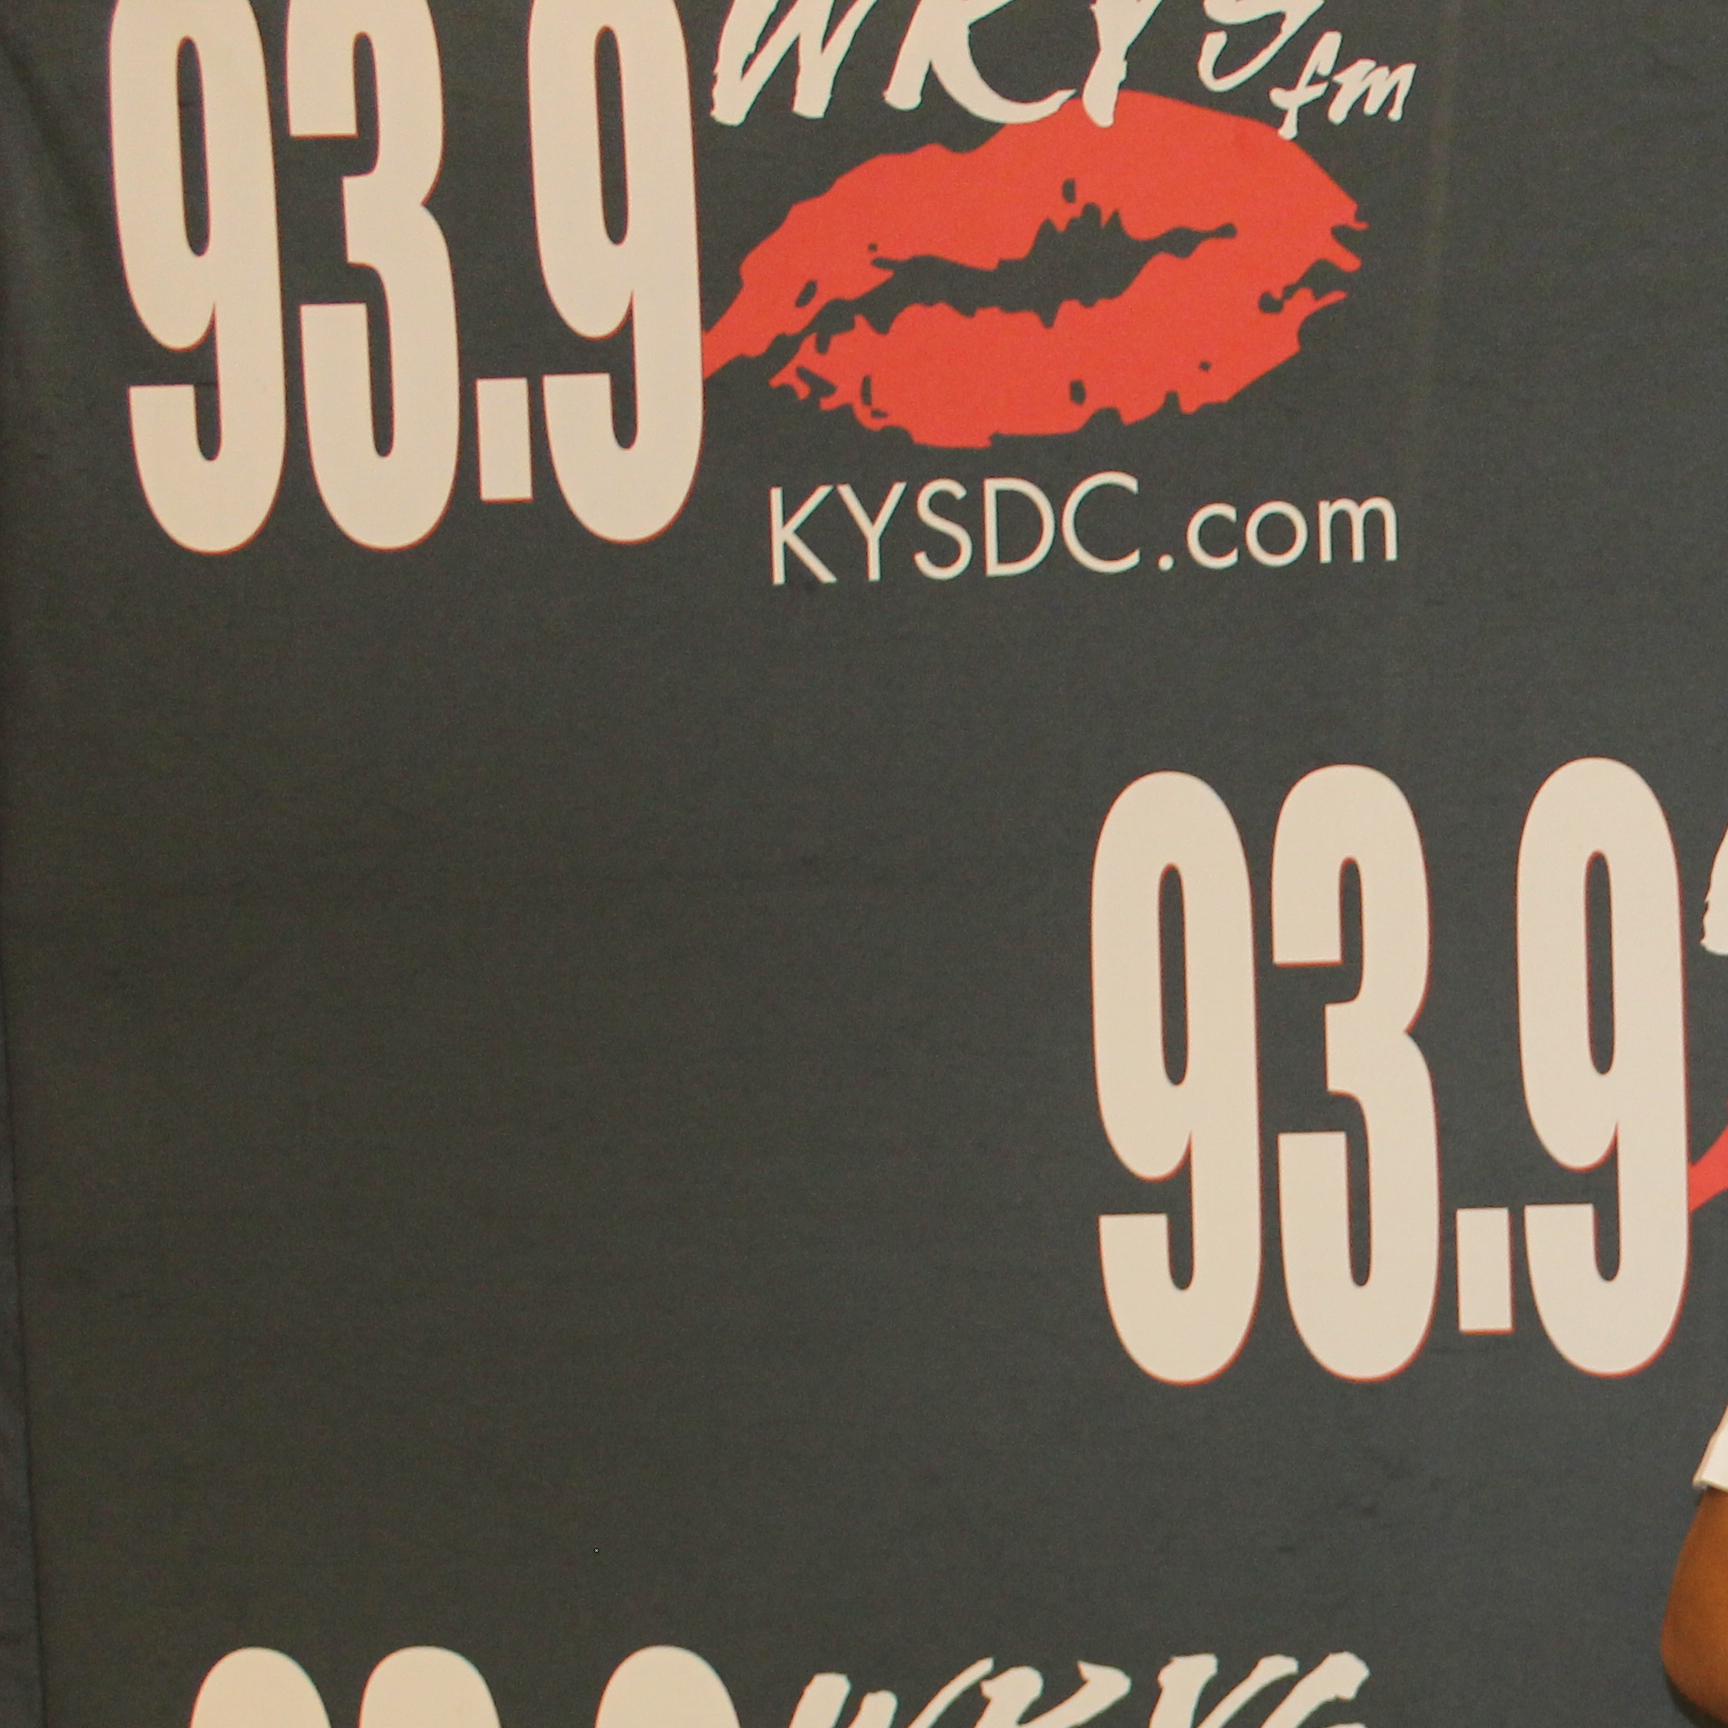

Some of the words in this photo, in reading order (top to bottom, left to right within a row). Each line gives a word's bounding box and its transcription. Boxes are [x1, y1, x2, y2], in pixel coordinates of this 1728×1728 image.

[109, 0, 705, 553] 93.9
[1269, 32, 1417, 141] fm
[770, 471, 1399, 585] KYSDC.com
[1091, 757, 1691, 1385] 93.9
